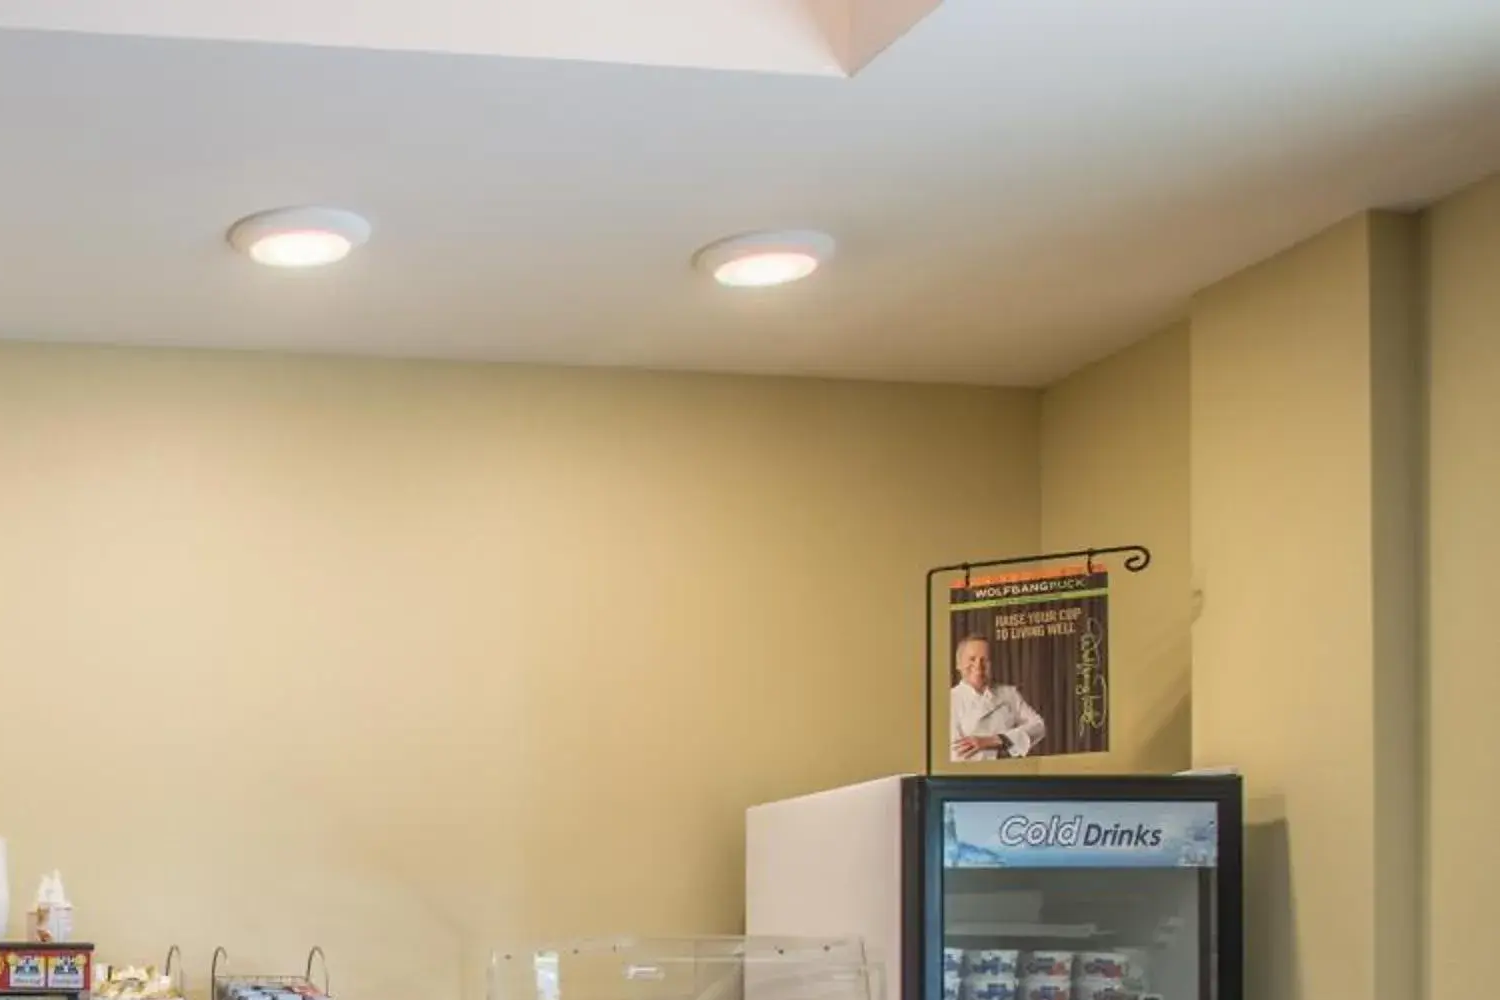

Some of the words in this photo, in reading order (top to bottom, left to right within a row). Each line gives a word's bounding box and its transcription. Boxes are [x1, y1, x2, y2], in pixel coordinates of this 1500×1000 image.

[995, 613, 1027, 628] RAISE
[1028, 610, 1057, 625] YOUR
[1059, 607, 1082, 621] CUP
[996, 628, 1009, 641] TO
[1011, 624, 1046, 639] LIVING
[1047, 621, 1077, 635] WELL
[1000, 814, 1084, 847] Cold
[1083, 823, 1164, 847] Drinks
